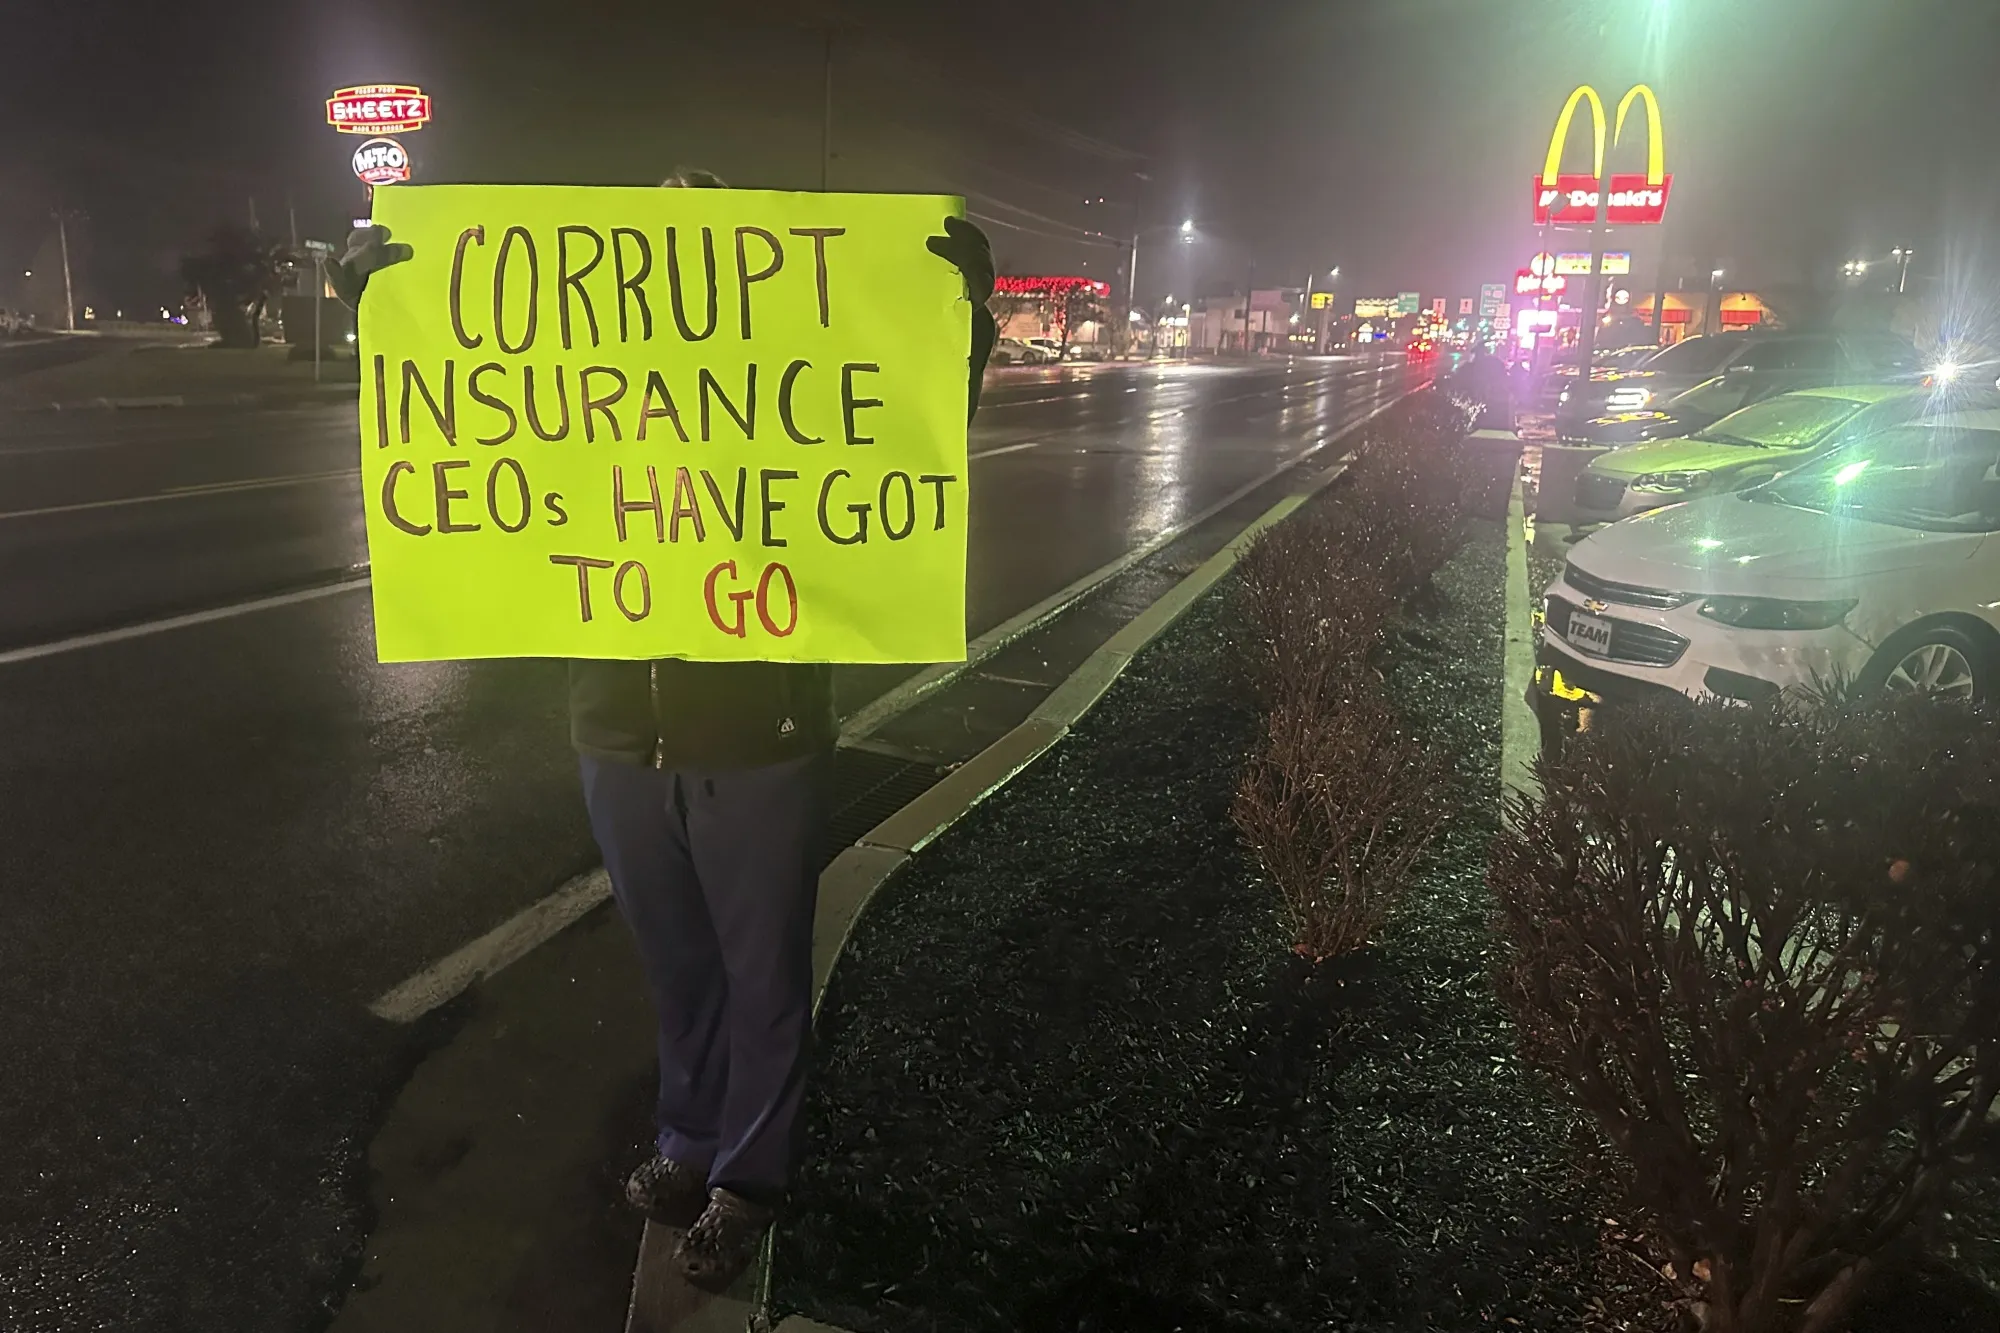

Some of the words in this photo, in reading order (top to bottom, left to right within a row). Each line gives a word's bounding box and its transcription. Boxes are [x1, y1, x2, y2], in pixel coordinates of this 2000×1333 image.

[332, 99, 421, 120] SHEETZ
[450, 224, 846, 355] CORRUPT
[374, 354, 884, 450] INSURANCE
[382, 458, 569, 537] CEOs
[612, 465, 800, 548] HAVE
[817, 469, 958, 546] GOT
[549, 554, 652, 623] TO
[703, 559, 798, 639] GO
[1570, 620, 1610, 646] TEAM
